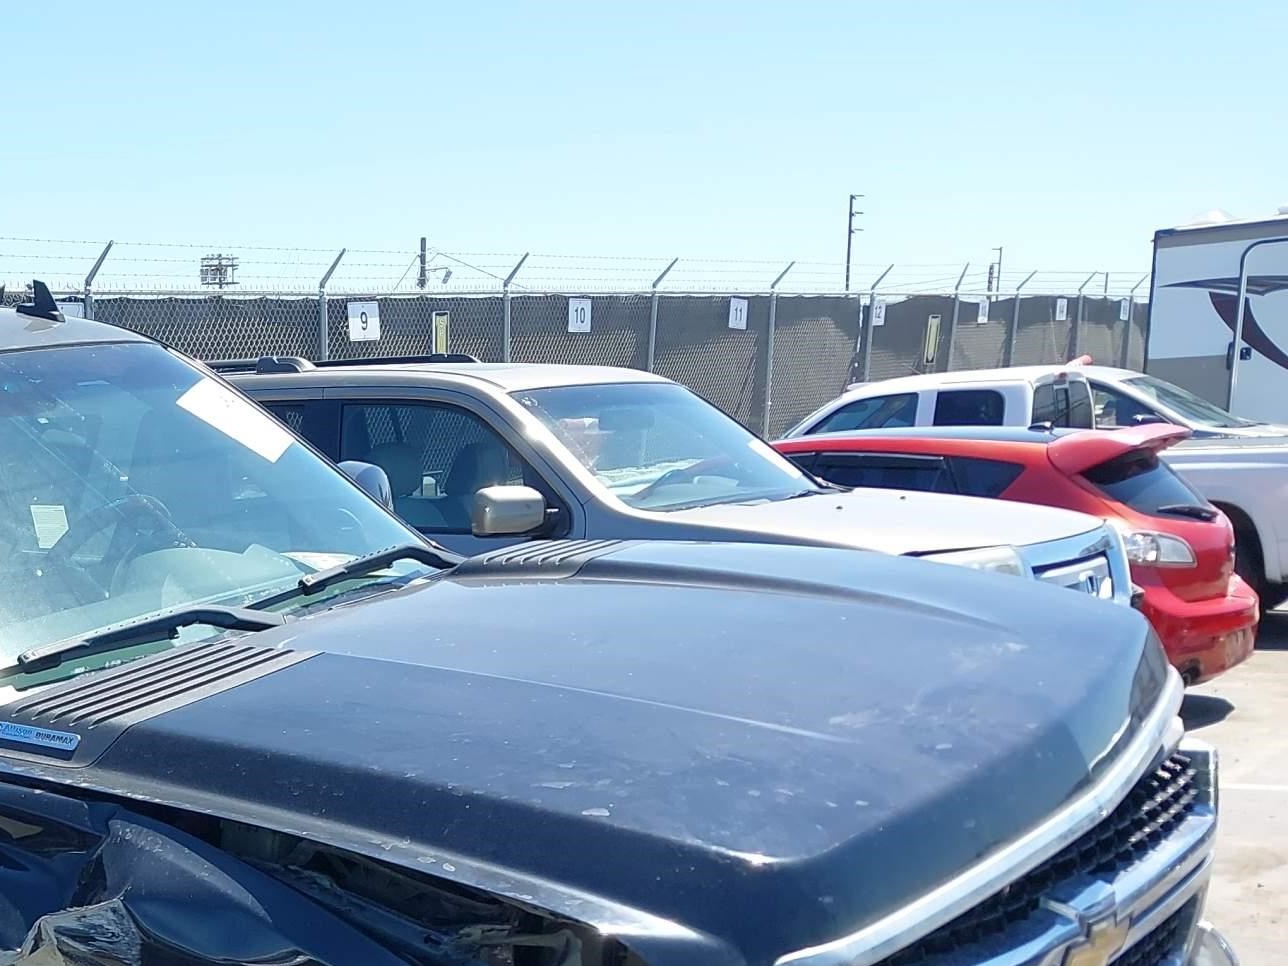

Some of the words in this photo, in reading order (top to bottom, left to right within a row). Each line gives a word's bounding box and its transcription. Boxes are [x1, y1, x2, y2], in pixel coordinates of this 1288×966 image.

[360, 311, 368, 331] 9
[574, 307, 586, 324] 10
[734, 306, 743, 321] 11
[36, 731, 75, 746] DURAMAX
